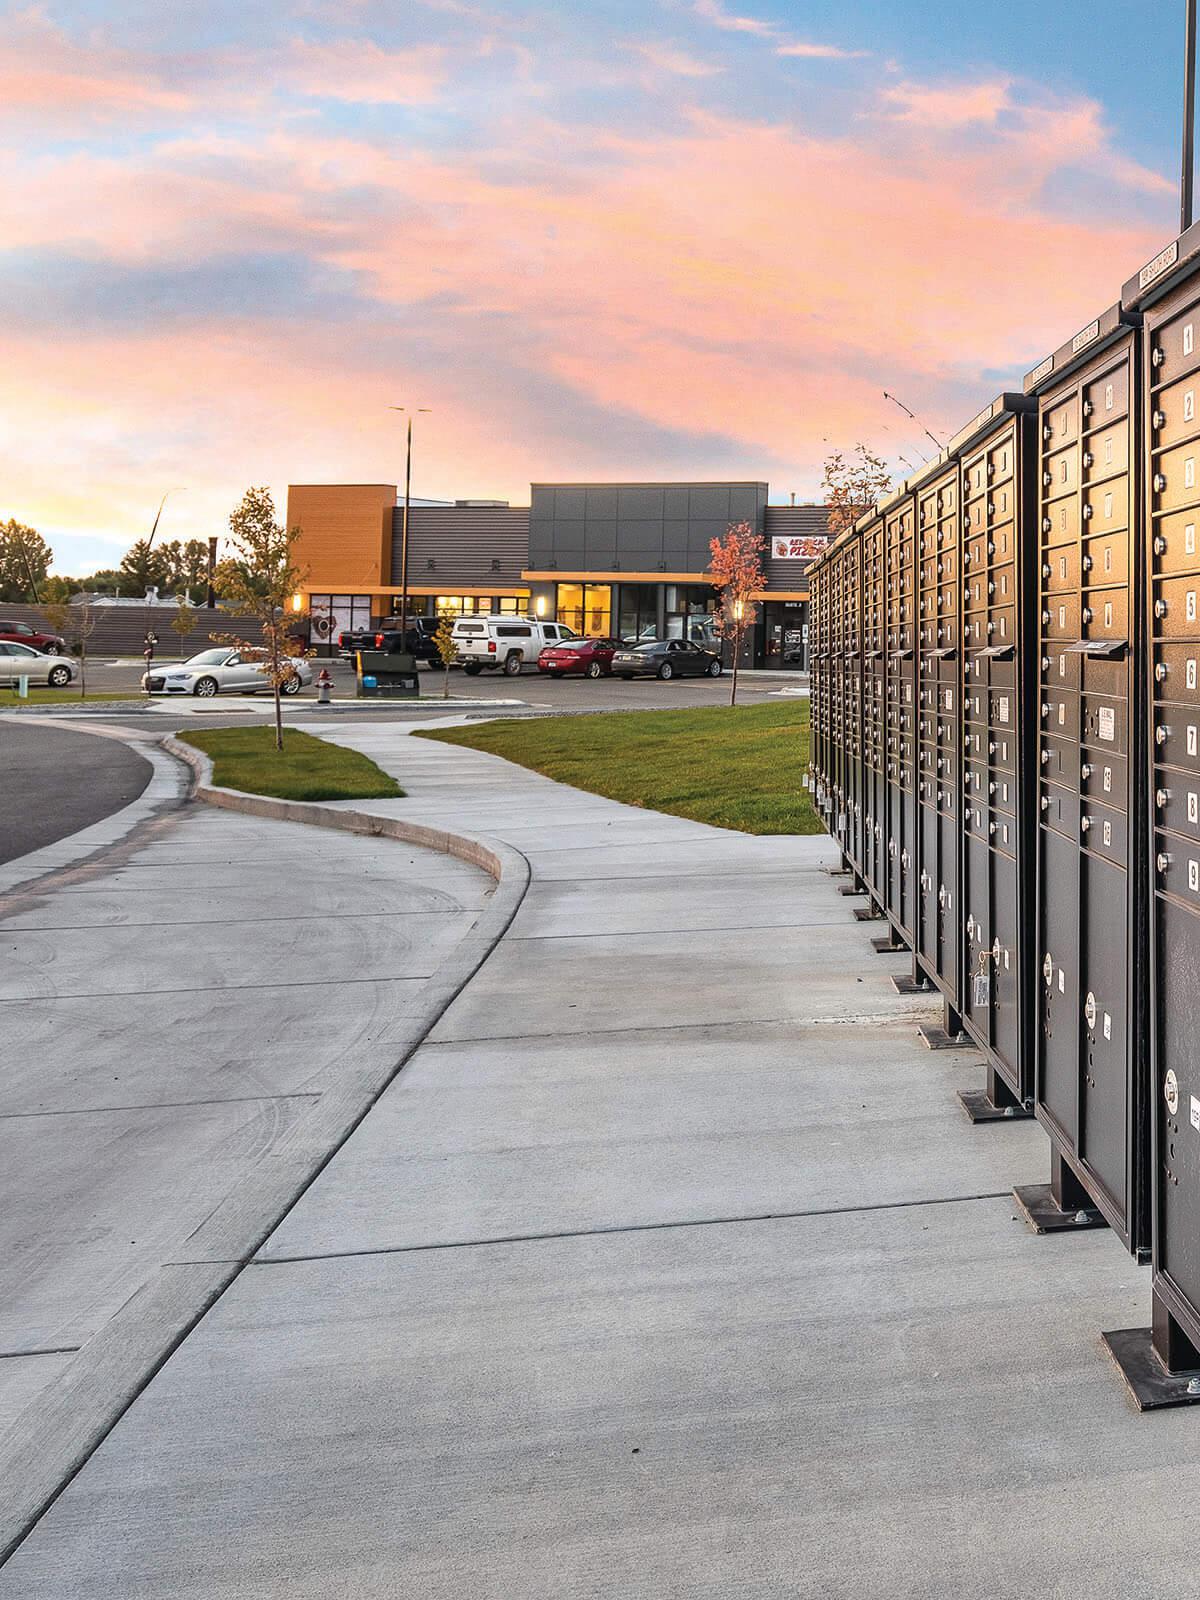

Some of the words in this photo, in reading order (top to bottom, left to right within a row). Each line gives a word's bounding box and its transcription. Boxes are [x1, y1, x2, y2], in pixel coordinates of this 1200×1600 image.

[1186, 396, 1192, 417] 2
[1188, 596, 1194, 617] 5
[1188, 665, 1195, 684] 6
[1189, 731, 1195, 750] 7
[1189, 799, 1196, 818] 8
[1190, 867, 1197, 886] 9
